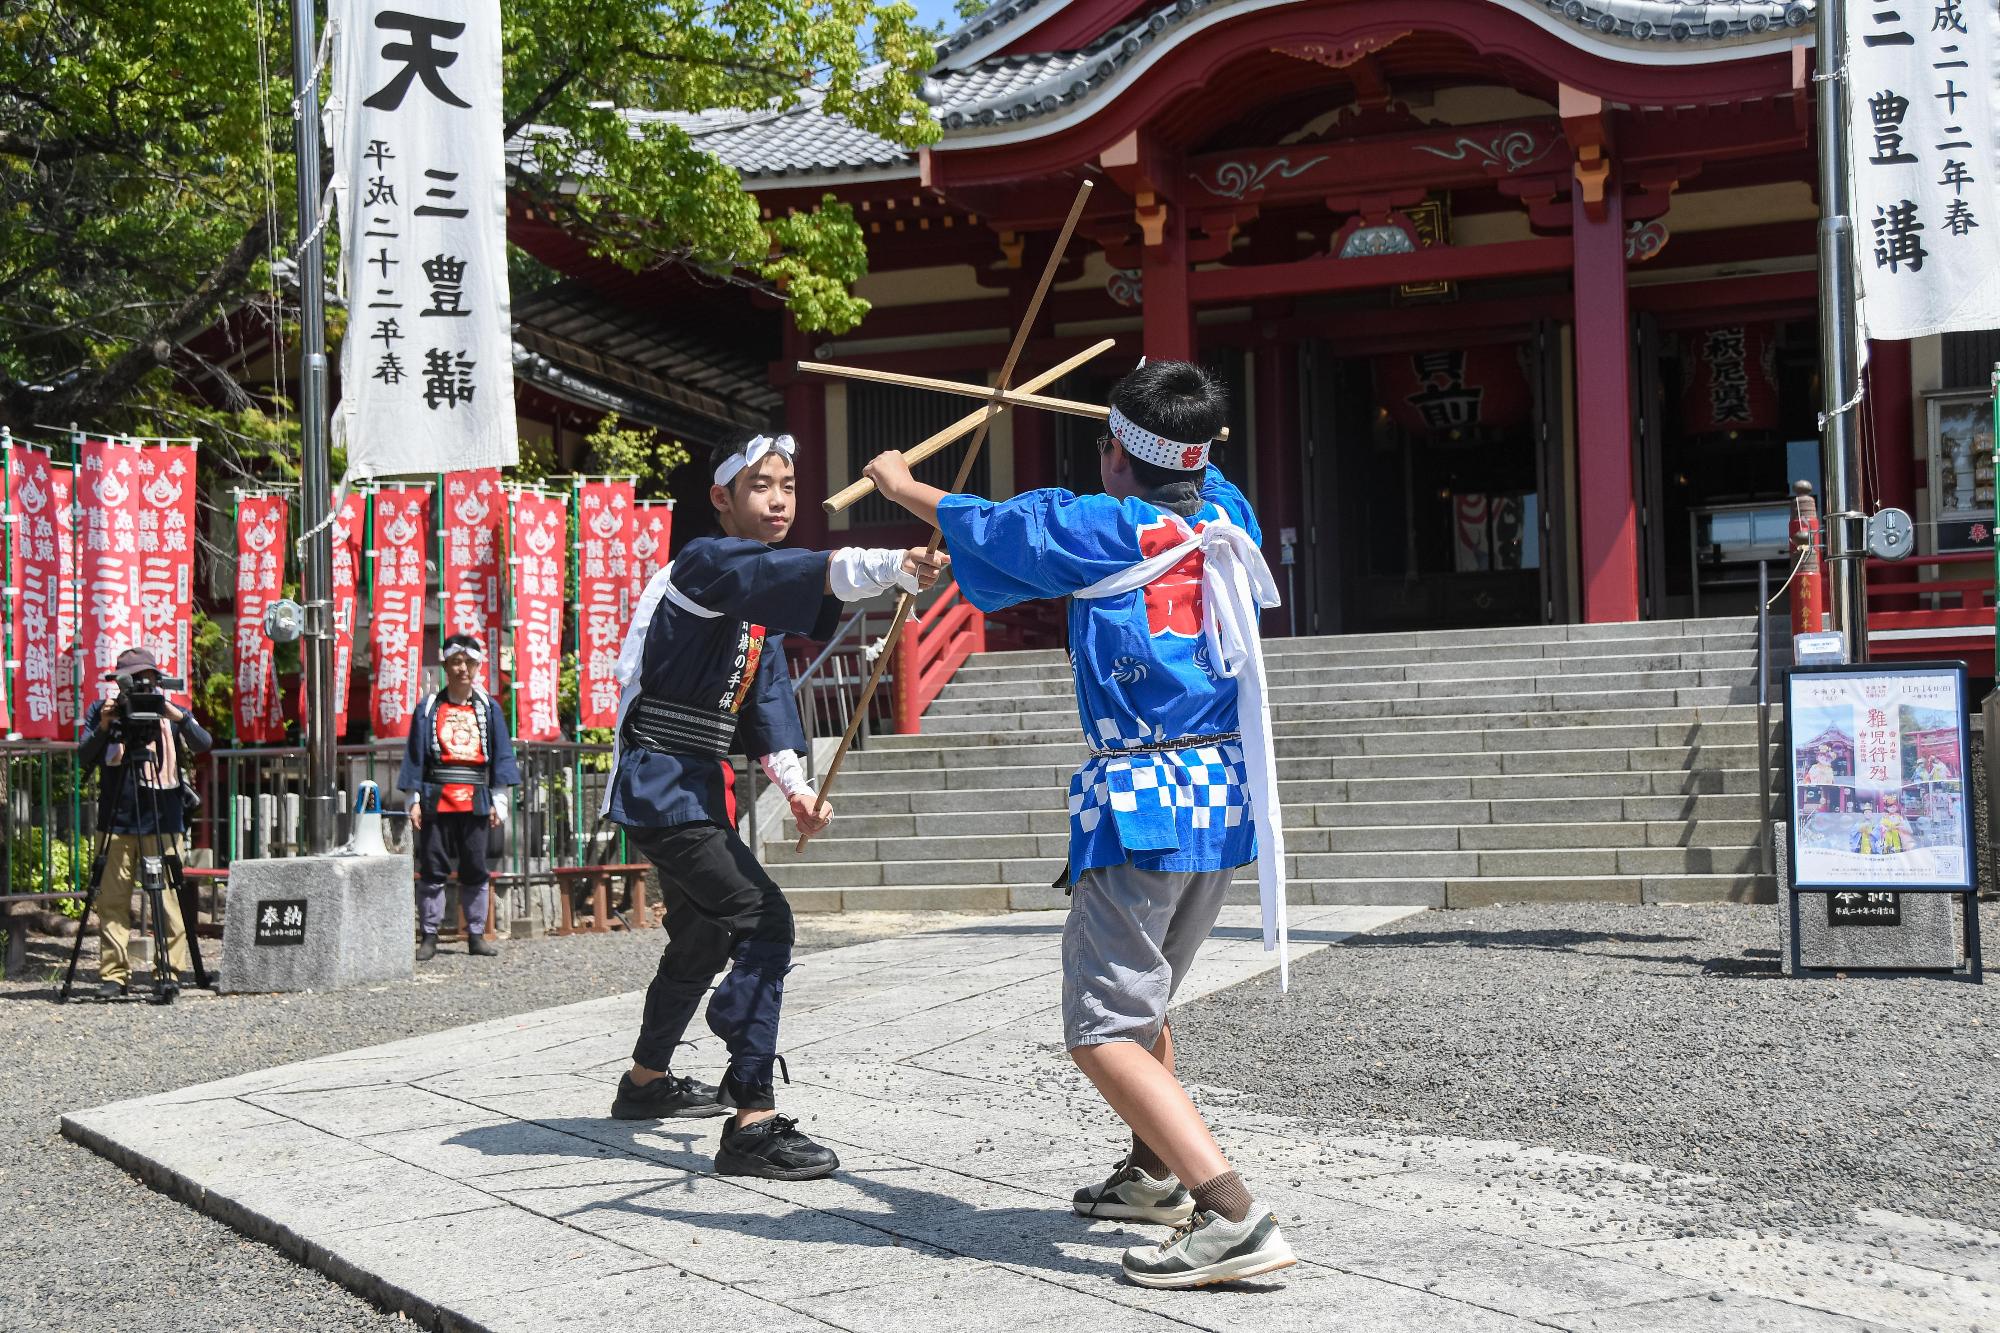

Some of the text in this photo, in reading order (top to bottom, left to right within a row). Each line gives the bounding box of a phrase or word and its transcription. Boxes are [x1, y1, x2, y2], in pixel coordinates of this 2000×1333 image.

[261, 905, 302, 928] 奉納
[1835, 907, 1894, 916] 平成二十年七月吉日
